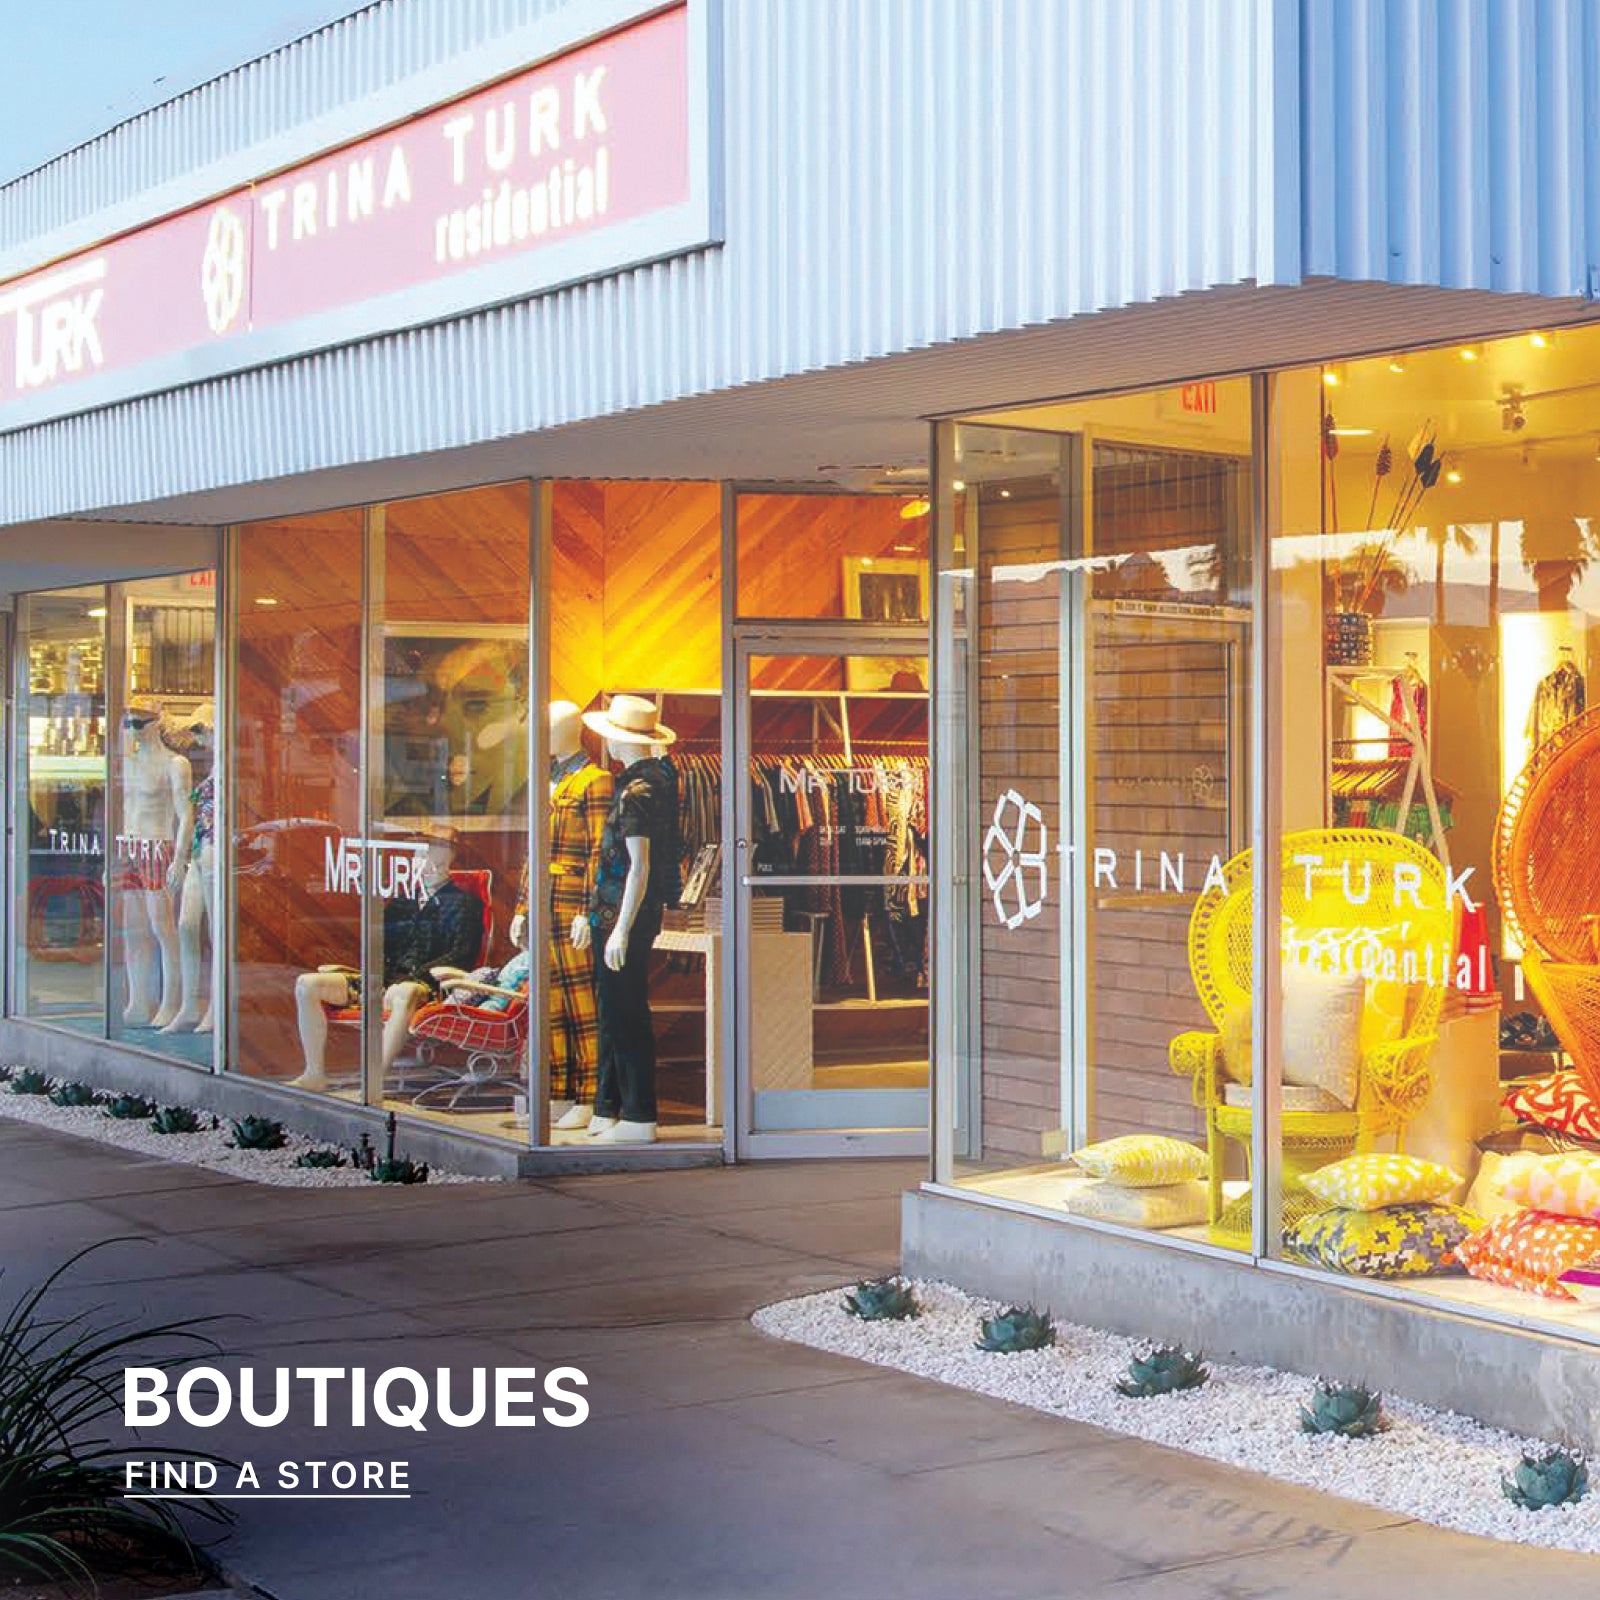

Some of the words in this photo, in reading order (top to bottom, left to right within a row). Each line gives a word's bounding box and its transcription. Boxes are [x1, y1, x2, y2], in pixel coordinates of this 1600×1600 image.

[261, 143, 412, 251] TRINA
[442, 64, 608, 186] TURK
[434, 145, 609, 264] residential
[49, 828, 101, 856] TRINA
[115, 834, 163, 860] TURK
[1056, 843, 1230, 897] TRINA
[1293, 854, 1476, 913] TURK
[1290, 937, 1487, 993] residential
